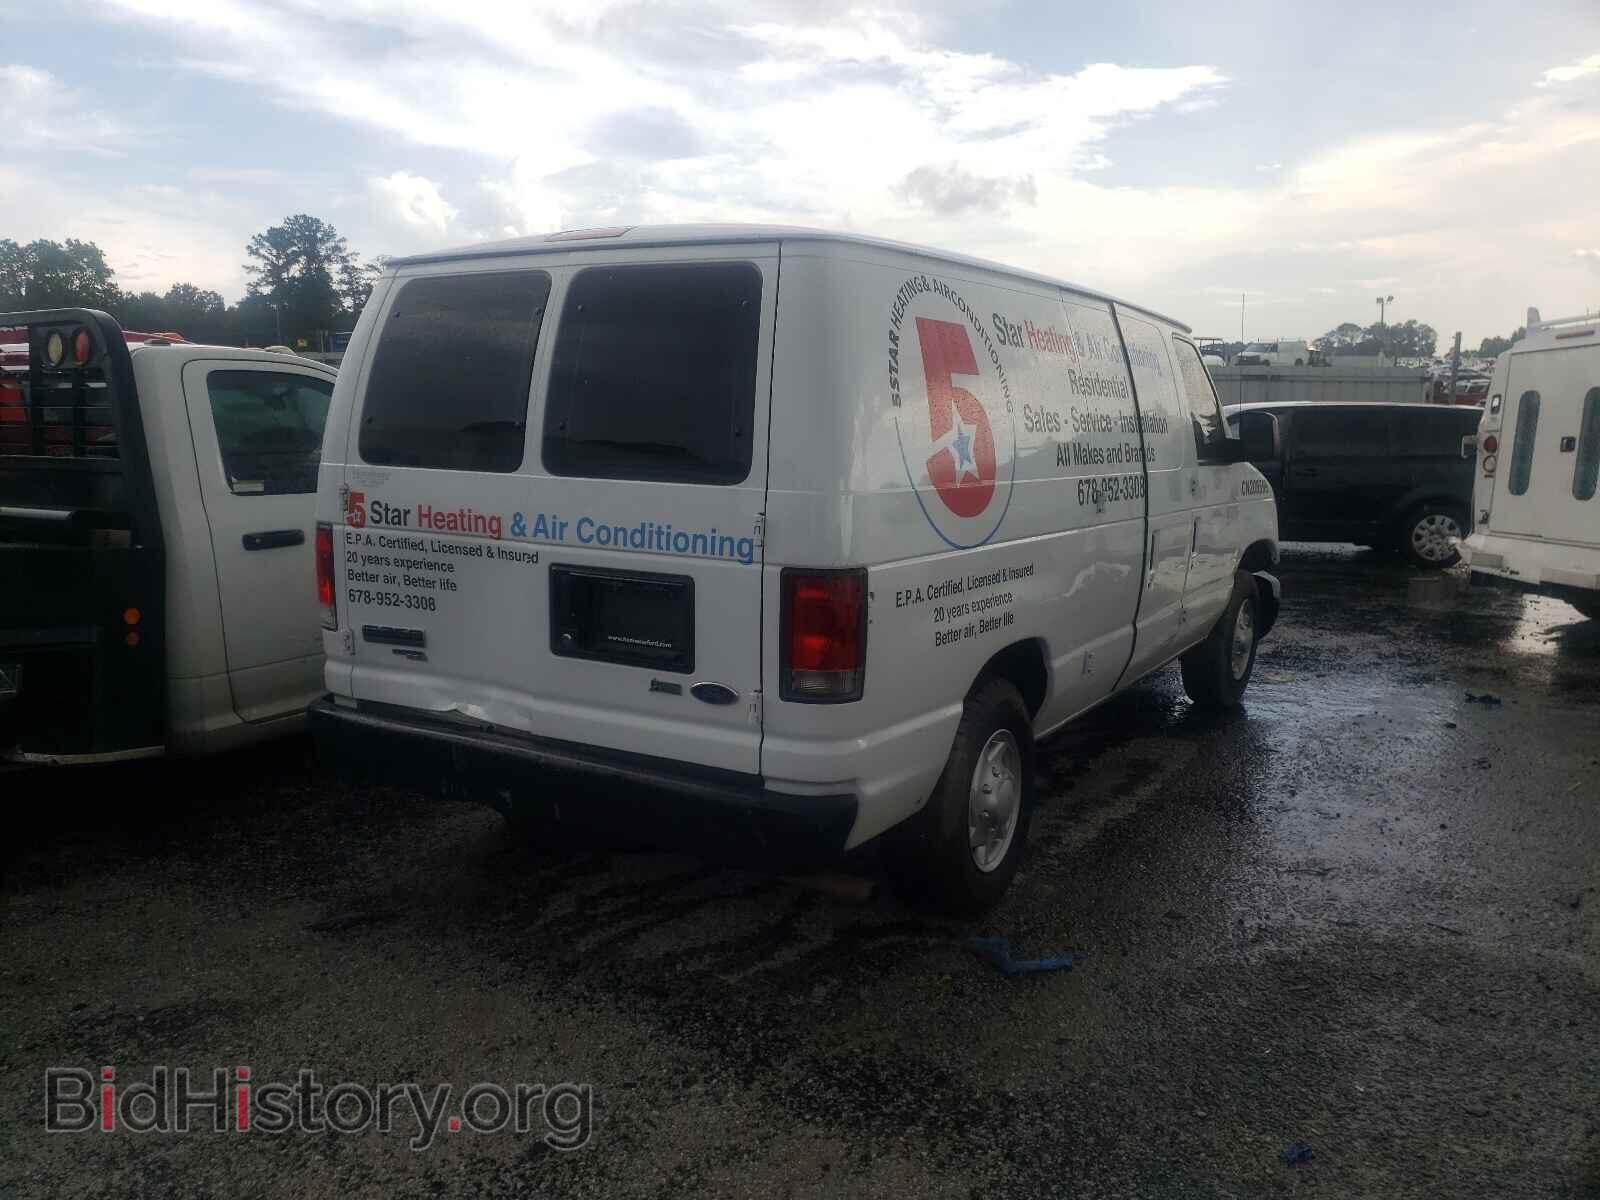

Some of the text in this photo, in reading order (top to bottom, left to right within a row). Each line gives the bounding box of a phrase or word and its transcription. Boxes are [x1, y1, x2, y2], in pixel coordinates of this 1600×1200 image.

[992, 312, 1024, 349] Star
[1024, 319, 1079, 364] Heating
[1068, 368, 1129, 399] Residential
[1071, 406, 1113, 433] Service
[1057, 442, 1071, 467] All
[1073, 442, 1105, 466] Makes
[1107, 444, 1123, 464] and
[1077, 475, 1146, 506] 678-952-3308
[347, 492, 754, 565] 5 Star Heating & Air Conditioning
[346, 533, 376, 547] E.P.A.
[379, 535, 428, 553] Certified,
[431, 541, 483, 558] Licensed
[486, 547, 494, 559] &
[347, 552, 455, 573] 20 years experience
[348, 569, 379, 583] Better
[404, 574, 436, 590] Better
[440, 576, 457, 592] life
[896, 587, 925, 608] E.P.A.
[967, 570, 1000, 591] Licensed
[1003, 569, 1008, 582] &
[1009, 563, 1034, 580] Insured
[348, 589, 436, 612] 678-952-3308
[934, 591, 1013, 623] 20 years experience
[935, 628, 961, 647] Better
[979, 617, 1001, 634] Better
